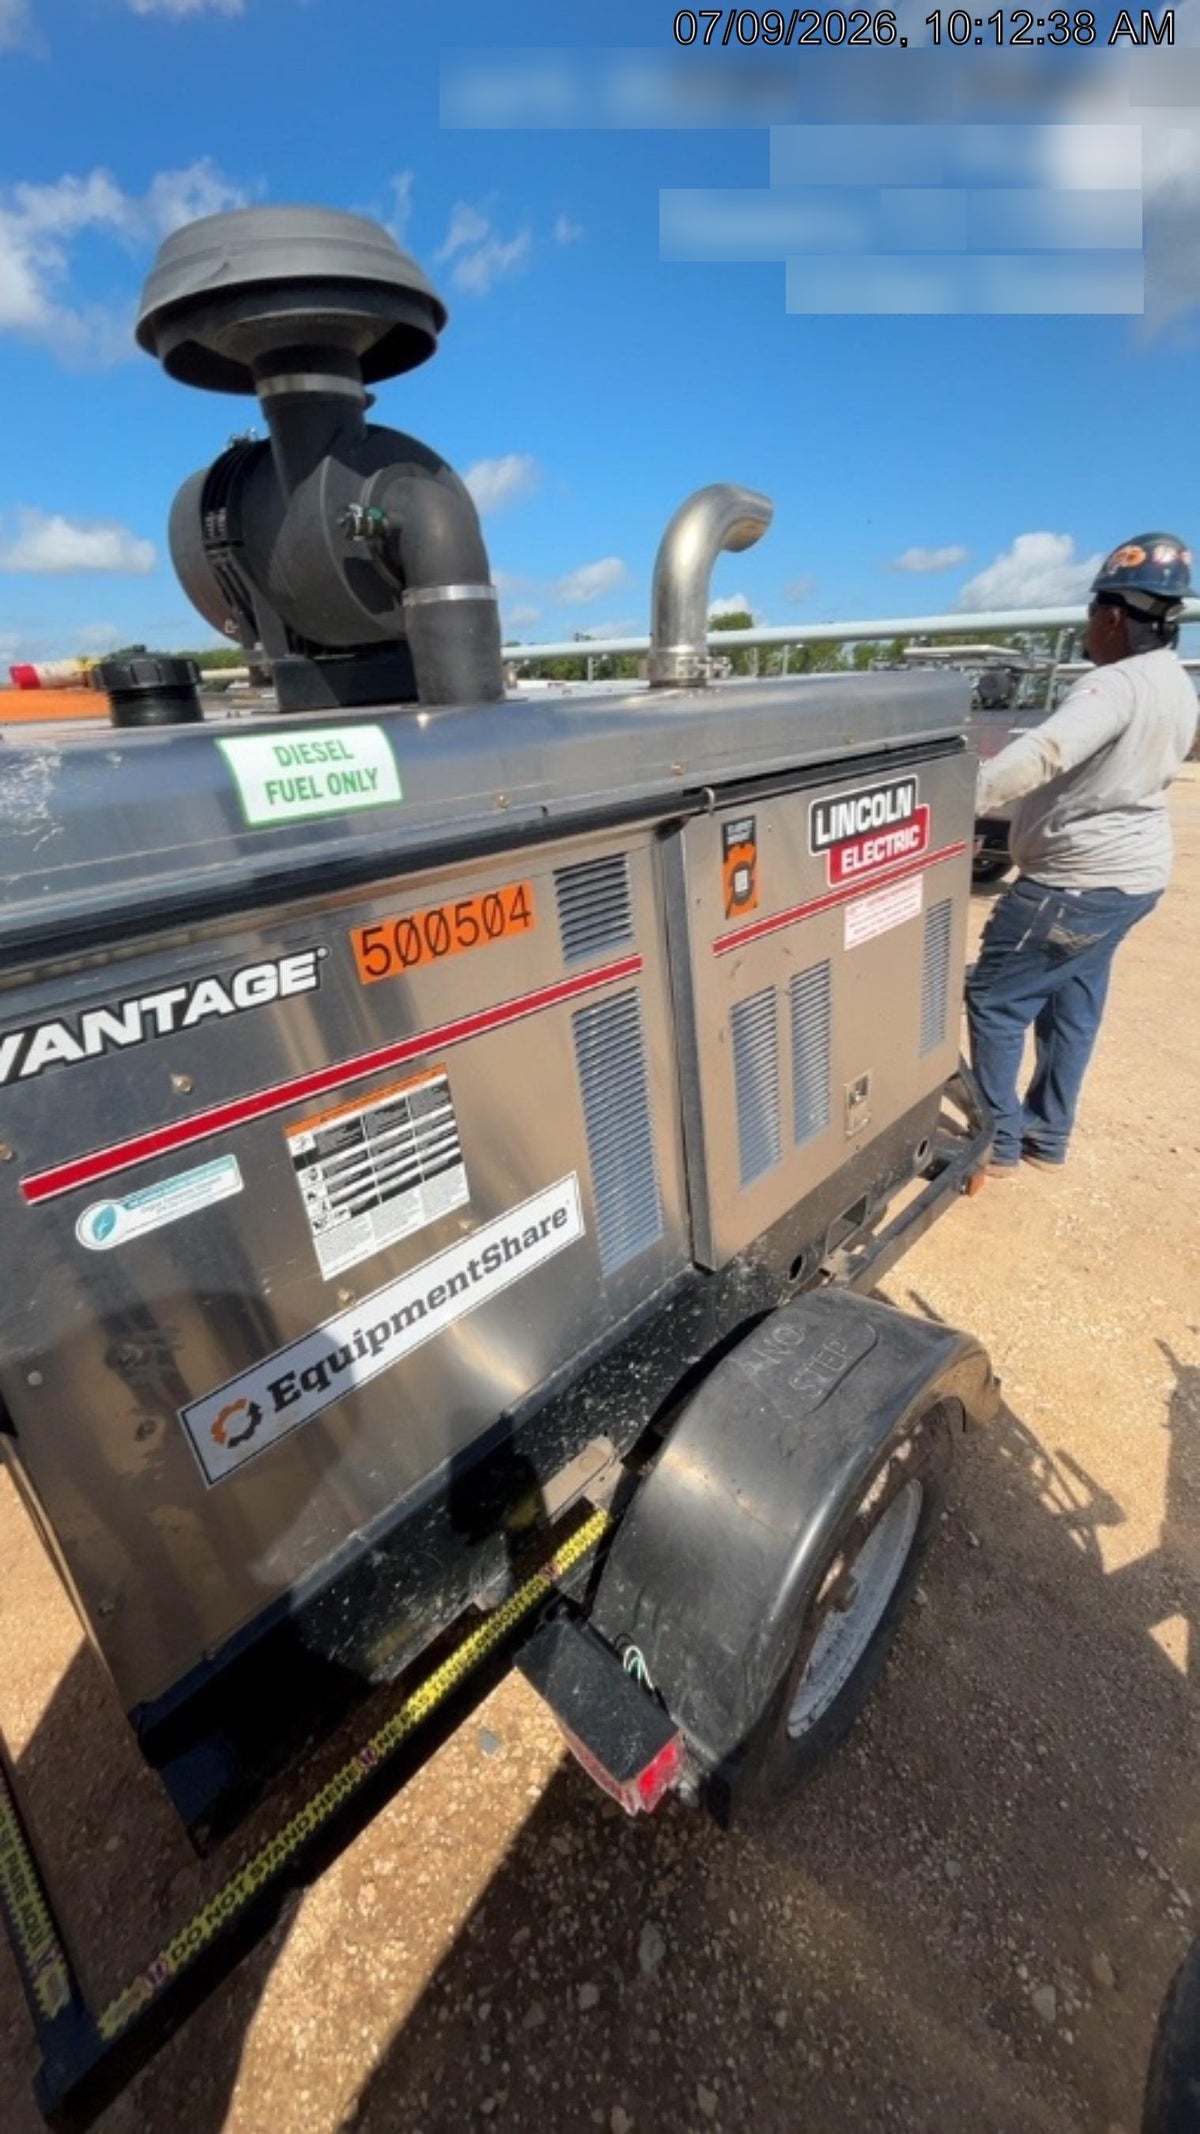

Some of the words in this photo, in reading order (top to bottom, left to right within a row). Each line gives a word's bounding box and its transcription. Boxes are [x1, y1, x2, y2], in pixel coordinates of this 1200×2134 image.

[273, 740, 353, 767] DIESEL
[265, 776, 322, 805] FUEL
[327, 768, 377, 796] ONLY
[814, 784, 915, 846] LINCOLN
[841, 825, 920, 874] ELECTRIC
[361, 884, 532, 976] 500504
[266, 1207, 568, 1412] EquipmentShare
[165, 1922, 206, 1963] DO
[201, 1879, 249, 1926] NOT
[245, 1814, 313, 1880] STAND
